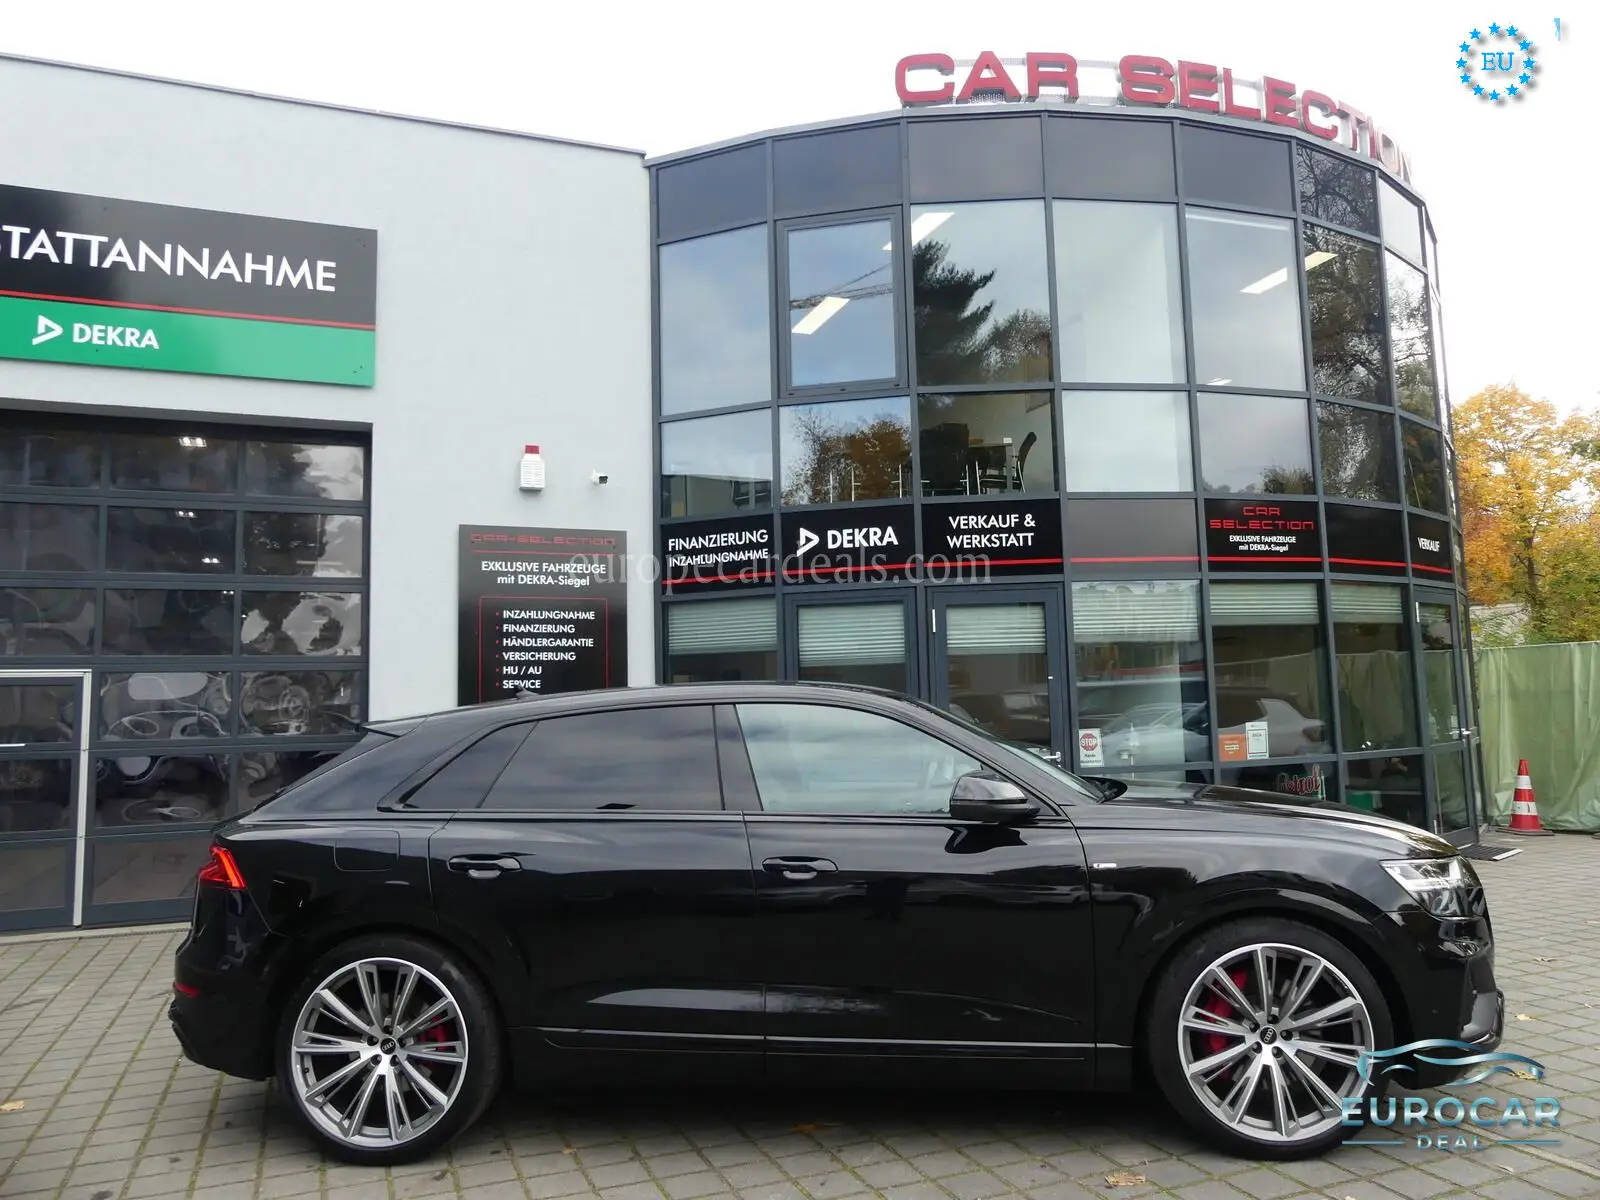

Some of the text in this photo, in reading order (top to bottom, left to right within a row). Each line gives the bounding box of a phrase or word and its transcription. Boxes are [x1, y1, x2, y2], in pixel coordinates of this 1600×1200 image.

[895, 51, 1412, 185] CAR SELECTION
[0, 225, 337, 292] TATTANNAHME
[72, 322, 160, 350] DEKRA
[1243, 506, 1281, 516] CAR
[948, 513, 1036, 530] VERKAUF &
[1209, 519, 1315, 530] SELECTION
[668, 529, 769, 551] FINANZIERUNG
[827, 525, 899, 550] DEKRA
[946, 532, 1034, 550] WERKSTATT
[1229, 535, 1260, 543] EXKLUSIVE
[1417, 536, 1441, 552] VERKAUF
[1249, 544, 1289, 553] DEKRA-Siegel
[669, 548, 769, 567] INZAHLUNGNAHME
[481, 560, 607, 574] EXKLUSIVE FAHRZEUGE
[497, 574, 590, 588] mit DEKRA-Siegel
[503, 610, 596, 620] INZAHLUNGNAHME
[503, 623, 576, 634] FINANZIERUNG
[503, 636, 594, 648] HÄNDLERGARANTIE
[502, 651, 577, 661] VERSICHERUNG
[503, 666, 518, 675] HU
[527, 666, 542, 675] AU
[1080, 737, 1098, 747] STOP
